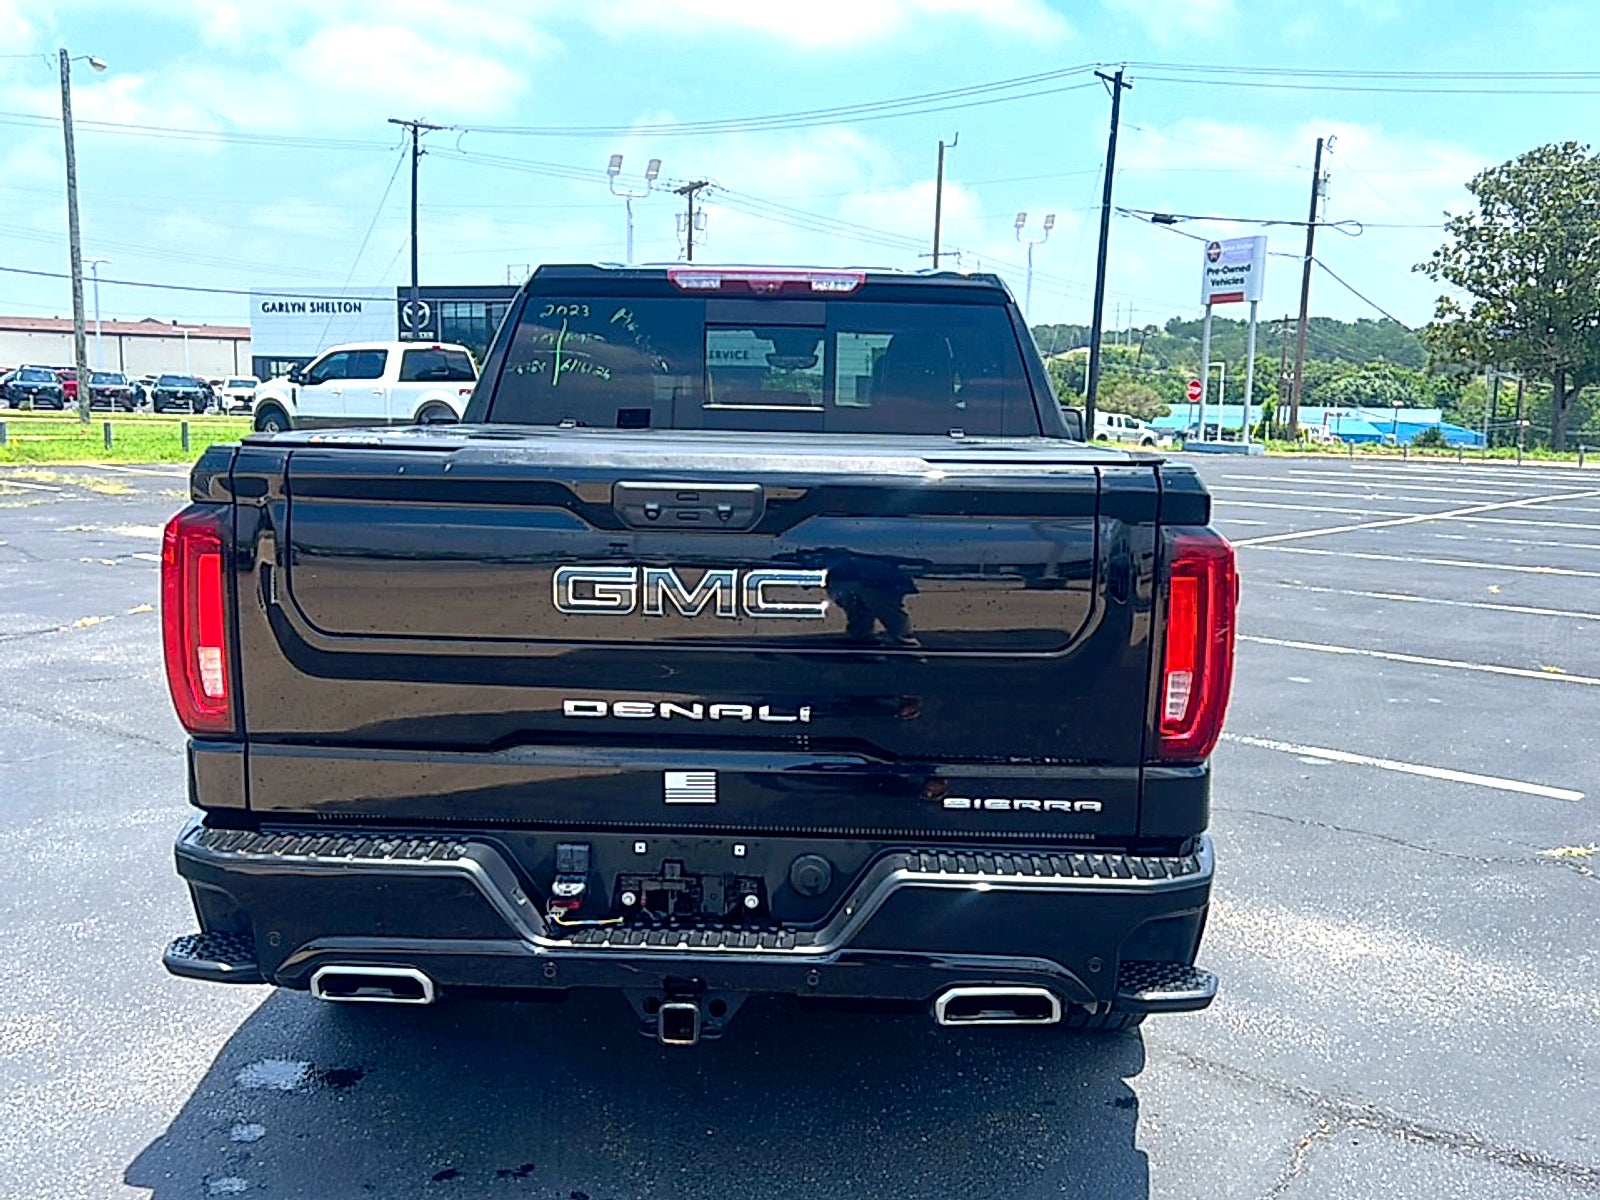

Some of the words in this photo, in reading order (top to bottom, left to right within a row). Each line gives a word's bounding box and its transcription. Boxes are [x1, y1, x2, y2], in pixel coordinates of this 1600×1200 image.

[1206, 263, 1252, 276] Pre-Owned
[1210, 277, 1245, 287] Vehicles
[261, 301, 306, 313] GARLYN
[310, 301, 362, 313] SHELTON
[539, 303, 590, 318] 2023
[709, 350, 750, 360] ERVICE
[553, 565, 829, 619] GMC
[563, 699, 812, 723] DENALI
[943, 797, 1102, 813] SIERRA
